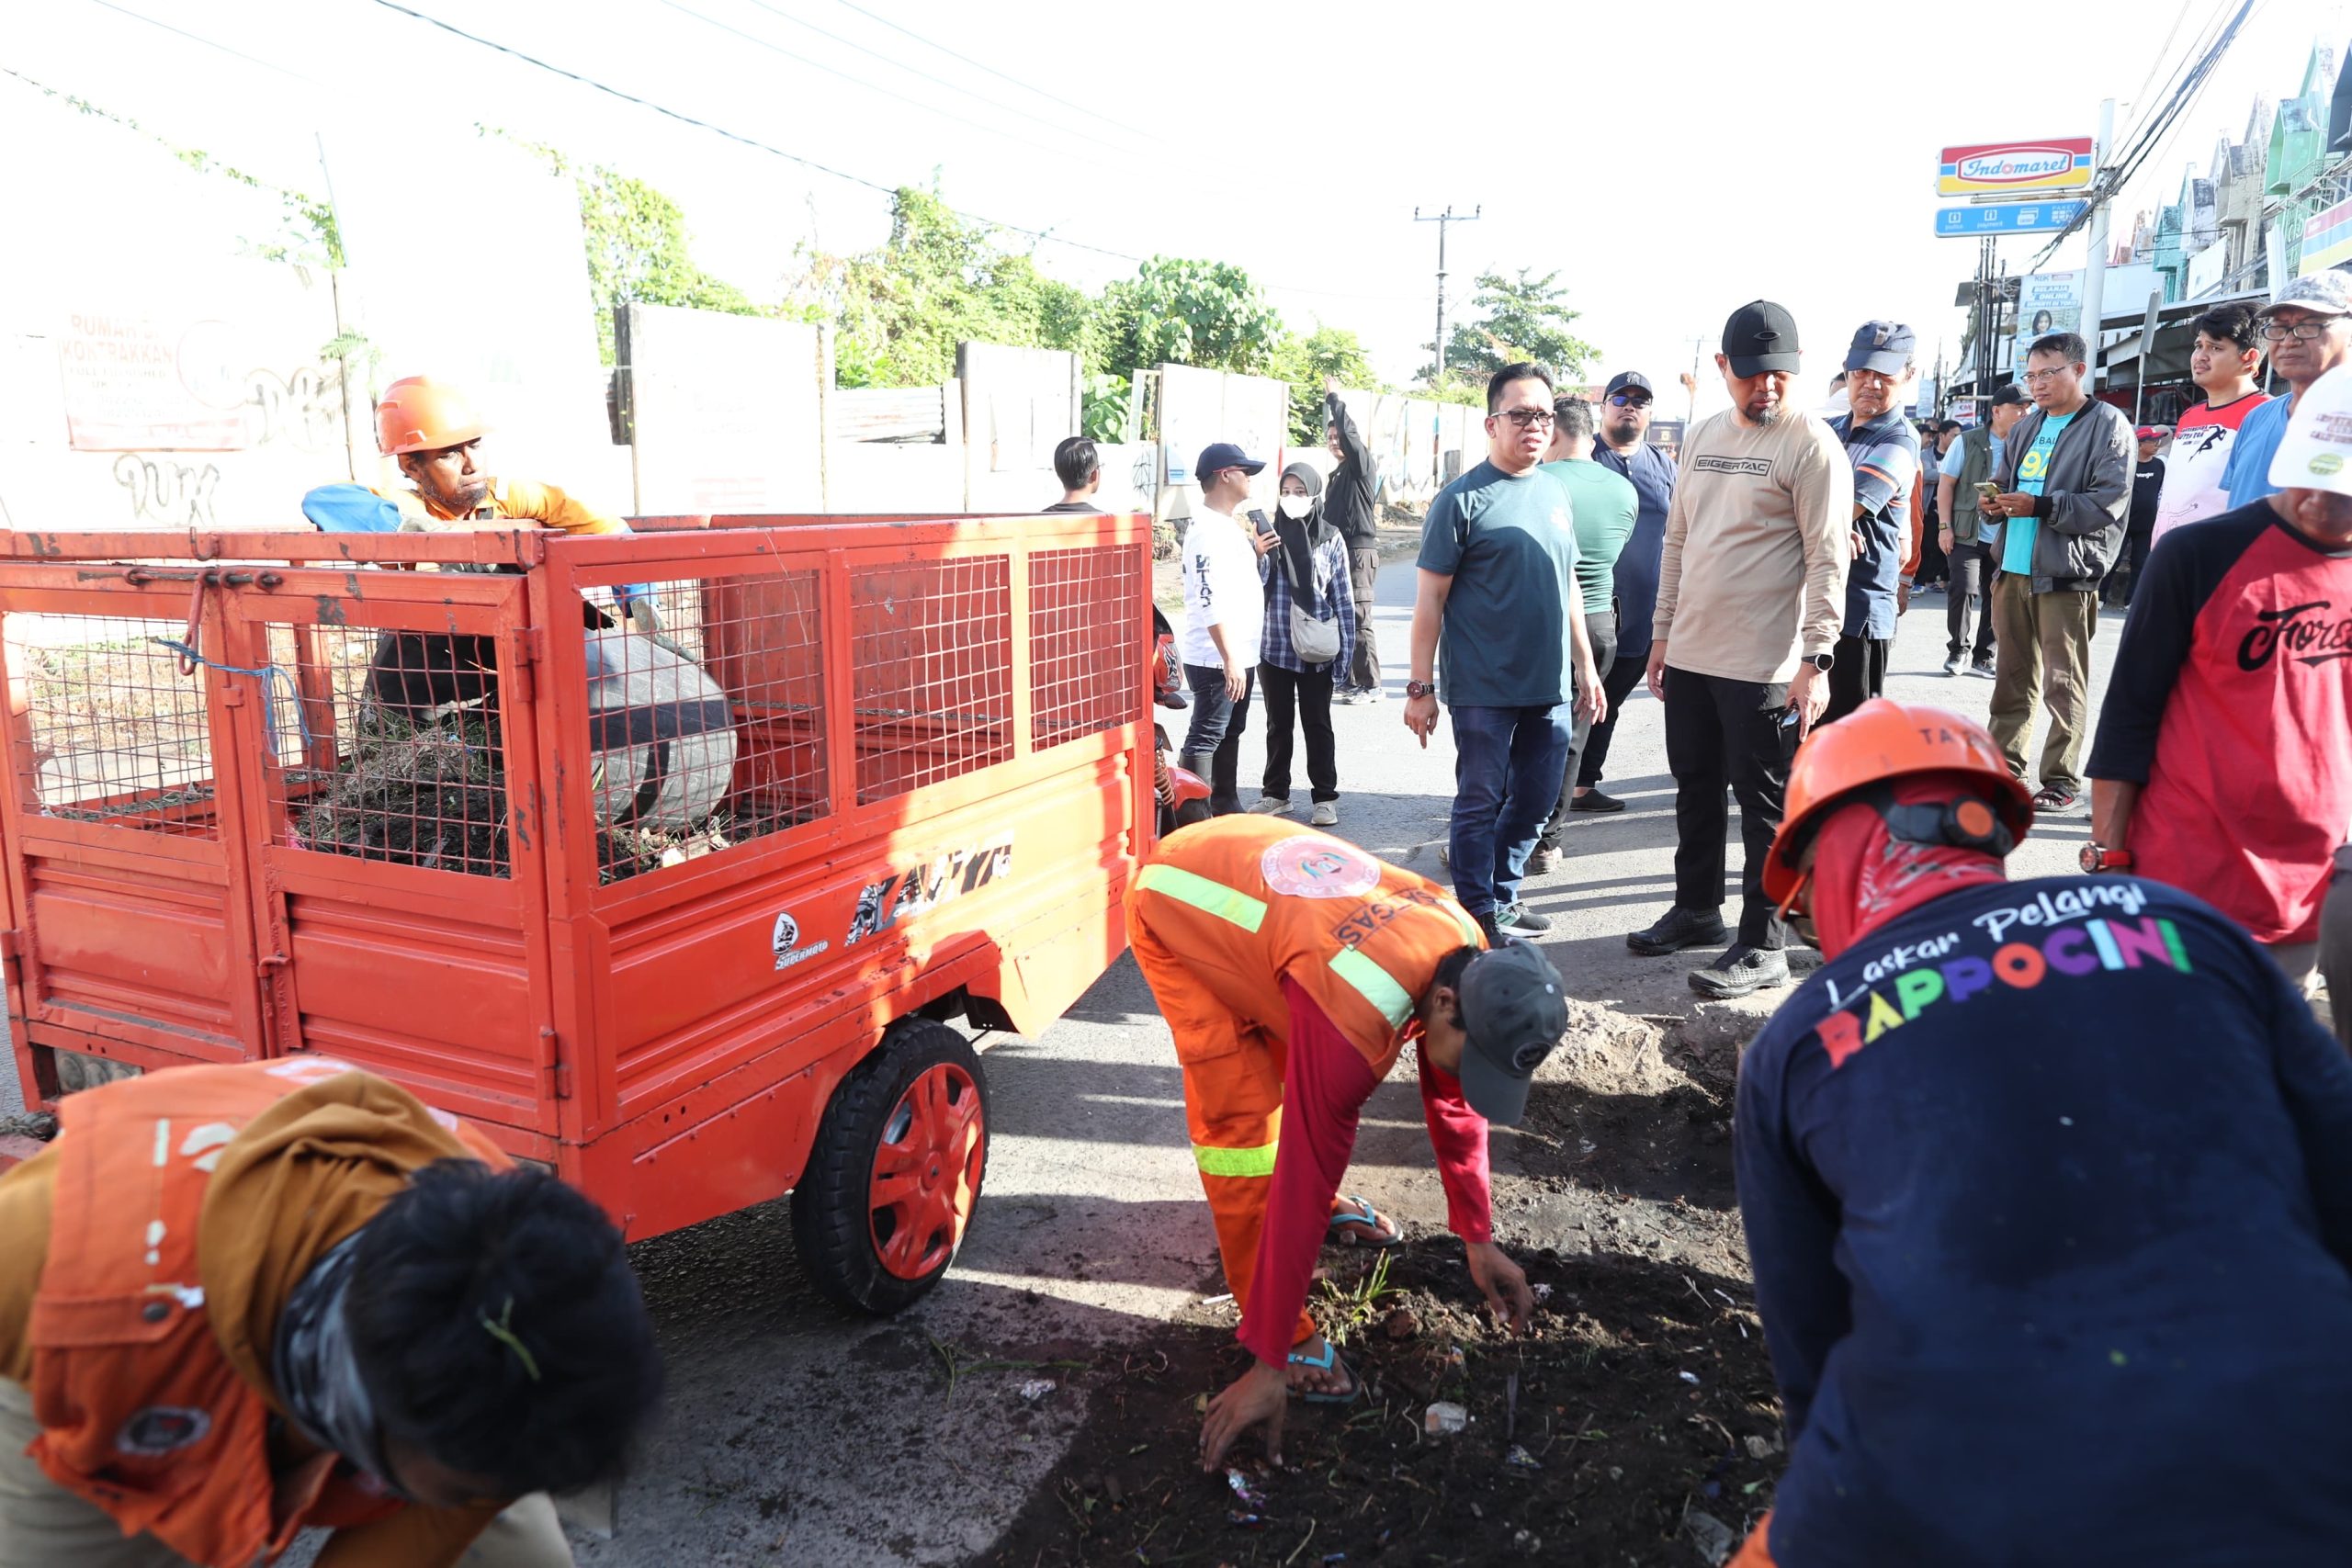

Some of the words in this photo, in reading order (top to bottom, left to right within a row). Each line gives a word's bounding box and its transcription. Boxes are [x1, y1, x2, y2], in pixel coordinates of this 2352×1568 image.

[1963, 155, 2068, 176] Indomaret
[1697, 459, 1768, 471] EIGERTAC
[775, 941, 829, 971] SUPERMOTO
[1826, 931, 1961, 1012] Laskar
[1972, 883, 2148, 943] Pelangi
[1815, 917, 2193, 1070] RAPPOCINI
